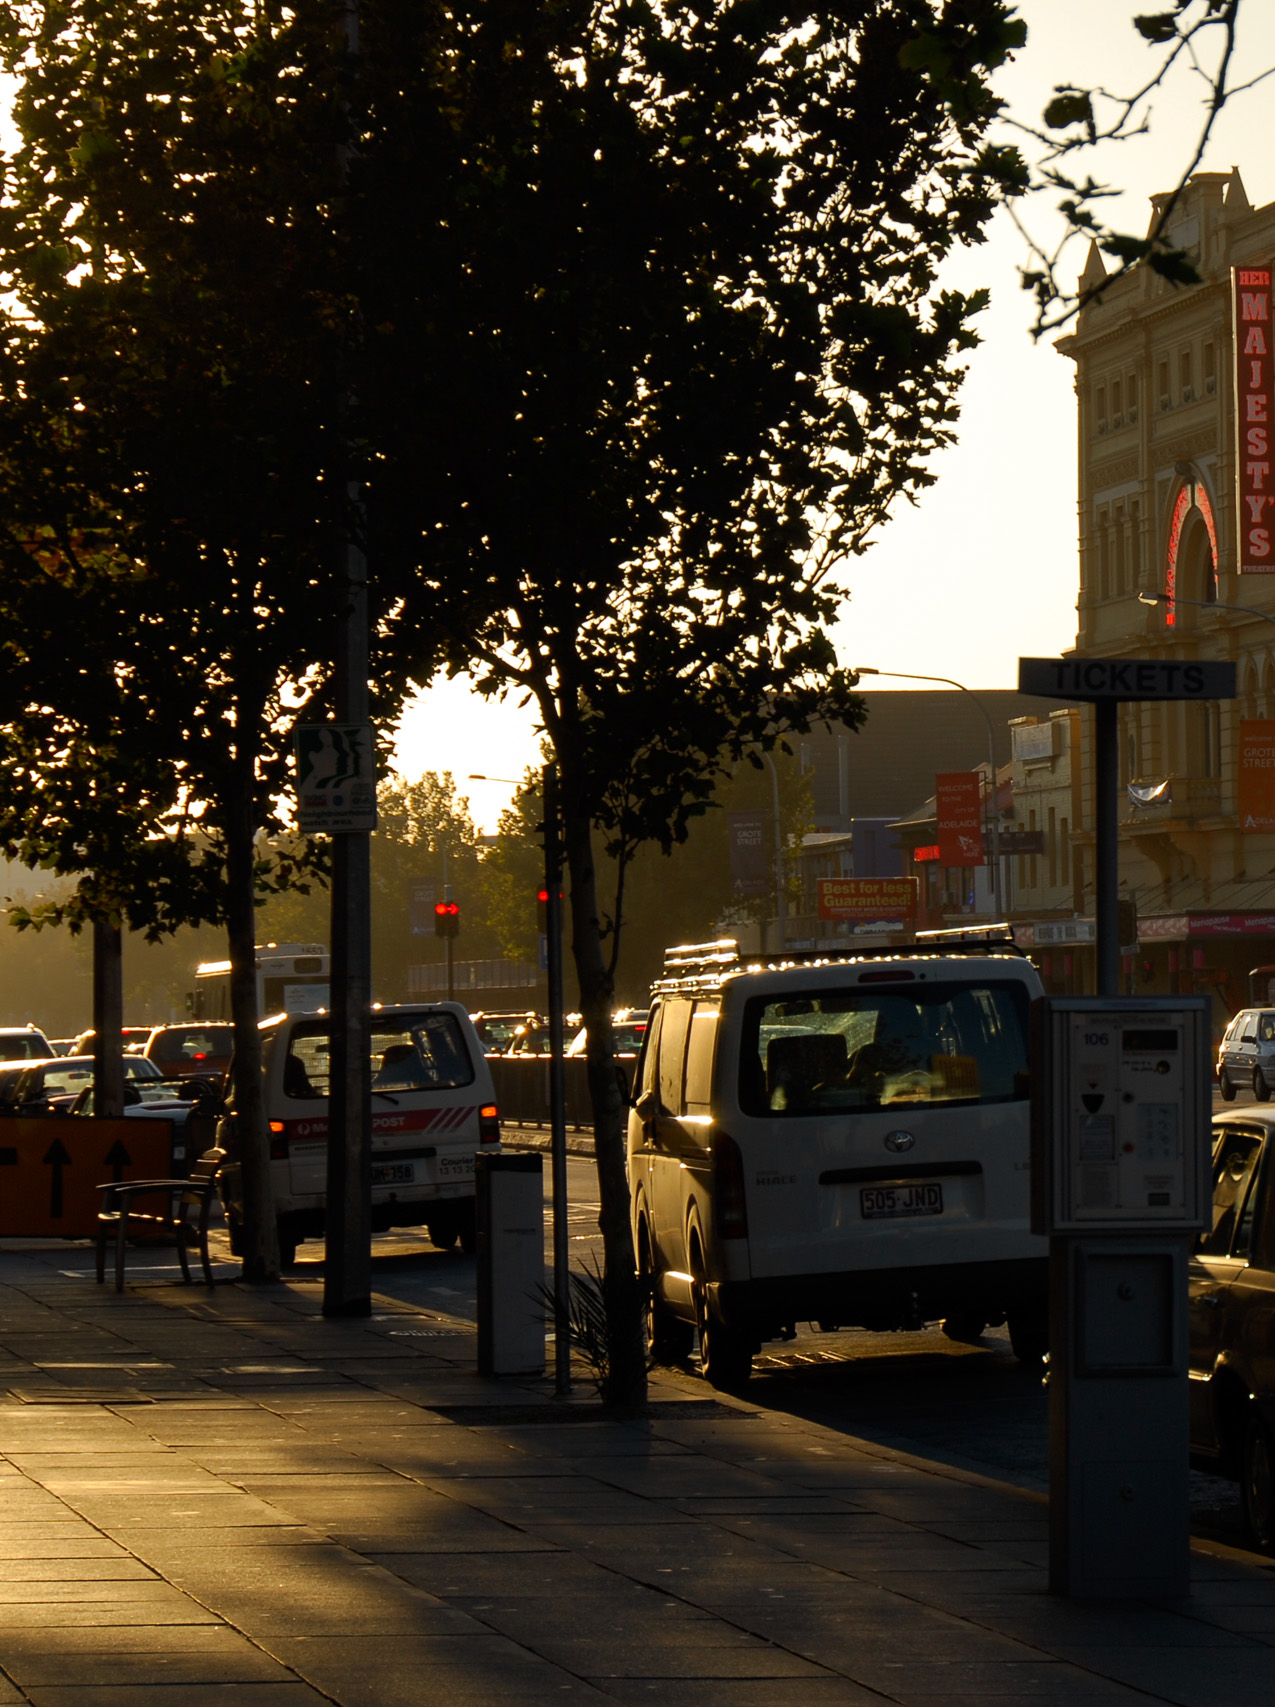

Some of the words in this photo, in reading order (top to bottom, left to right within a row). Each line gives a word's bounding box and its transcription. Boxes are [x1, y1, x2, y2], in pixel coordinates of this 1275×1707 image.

[1238, 270, 1271, 287] HER
[1241, 292, 1275, 558] MAJESTY'S
[1050, 662, 1206, 694] TICKETS
[938, 784, 974, 792] WELCOME
[300, 810, 374, 819] Neighbourhood
[938, 819, 980, 829] ADELAIDE
[736, 830, 763, 839] GROTE
[736, 837, 763, 847] STREET
[823, 882, 856, 895] Best
[859, 881, 879, 894] for
[882, 881, 913, 894] less
[823, 894, 912, 908] Guaranteed!
[1190, 916, 1231, 929] Menopause
[1083, 1032, 1110, 1046] 106
[372, 1117, 406, 1129] POST
[441, 1157, 476, 1166] Courier
[439, 1167, 449, 1175] 13
[453, 1166, 463, 1174] 13
[756, 1176, 798, 1186] HIACE
